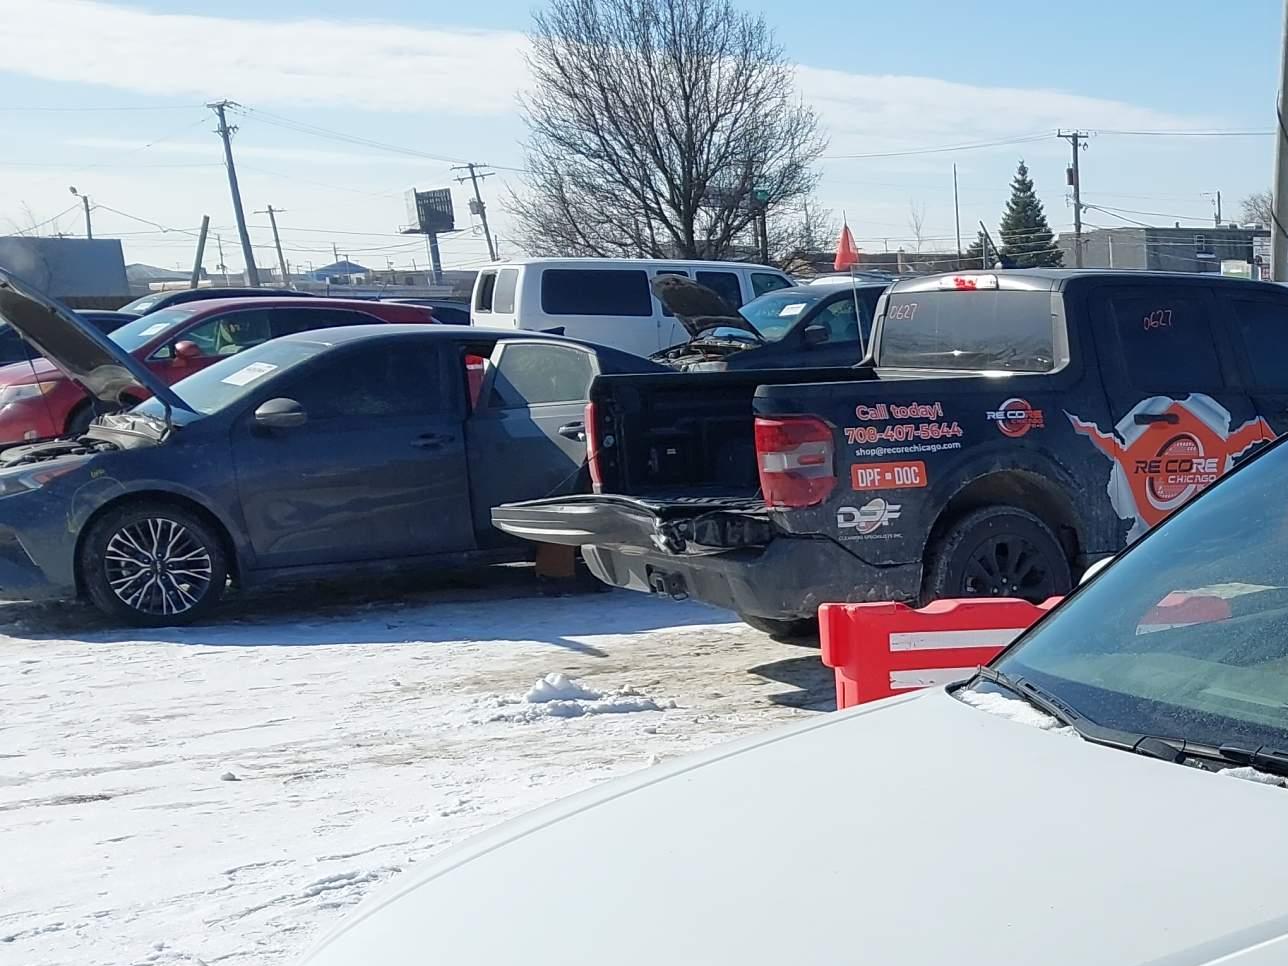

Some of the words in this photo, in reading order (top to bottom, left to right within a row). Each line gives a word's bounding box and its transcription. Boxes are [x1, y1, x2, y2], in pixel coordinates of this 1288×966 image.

[889, 303, 919, 321] 0627
[1143, 309, 1173, 331] 0627
[855, 403, 889, 421] Call
[890, 402, 944, 421] today!
[844, 421, 963, 445] 708-407-5644
[855, 441, 962, 457] shop@recorechicago.com
[1134, 460, 1161, 474] RE
[1165, 458, 1219, 473] CORE
[857, 468, 882, 488] DPF
[893, 466, 921, 485] DOC
[1167, 474, 1217, 484] CHICAGO
